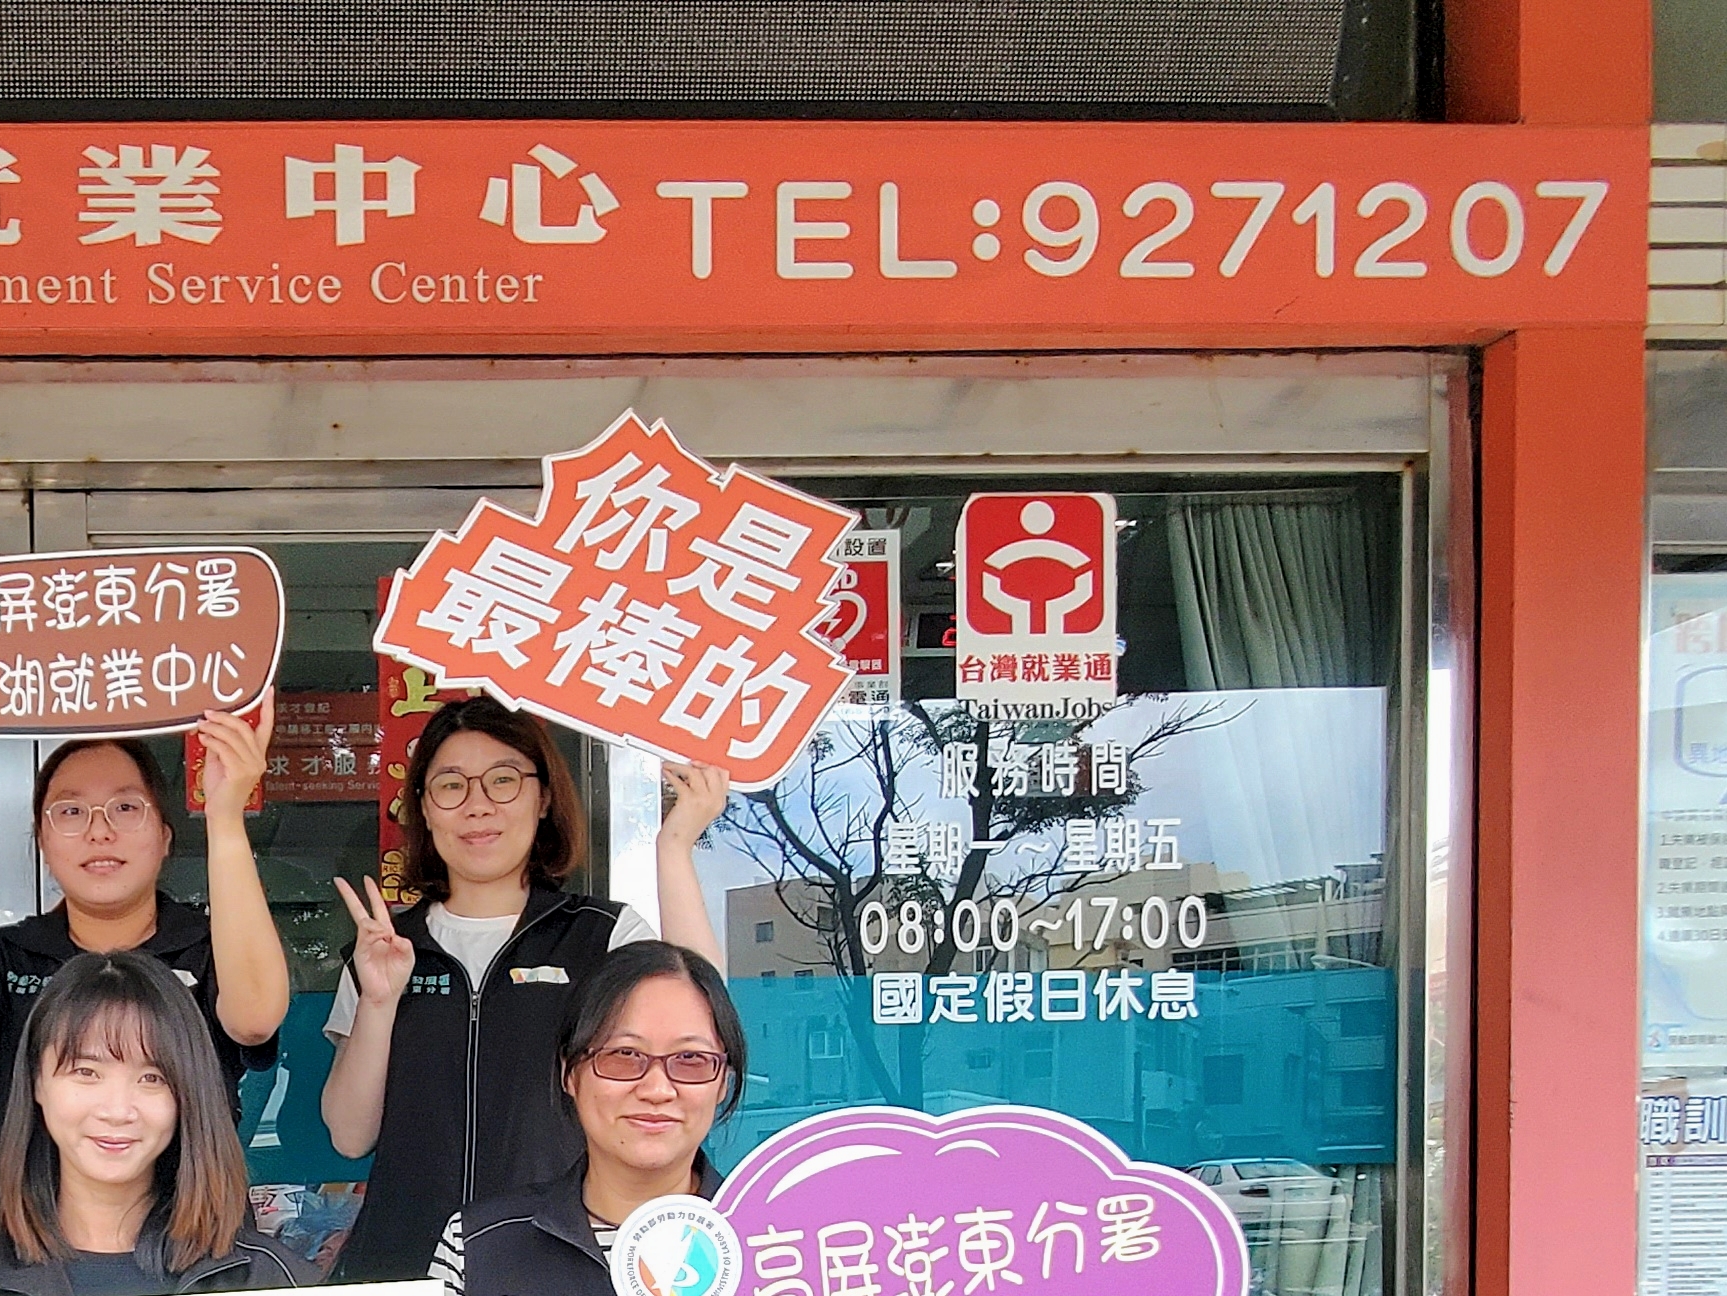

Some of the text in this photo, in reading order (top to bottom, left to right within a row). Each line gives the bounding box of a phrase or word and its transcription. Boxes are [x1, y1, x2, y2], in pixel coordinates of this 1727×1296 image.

[656, 181, 1609, 280] TEL:9271207
[147, 262, 342, 306] Service
[371, 262, 544, 306] Center
[554, 449, 813, 632] 你是
[417, 535, 810, 761] 最棒的
[958, 655, 1113, 683] 台灣就業通
[960, 697, 1114, 721] TaiwanJobs
[939, 742, 1129, 798] 服務時間
[859, 896, 1208, 955] 08:00~17:00
[873, 970, 1199, 1026] 國定假日休息
